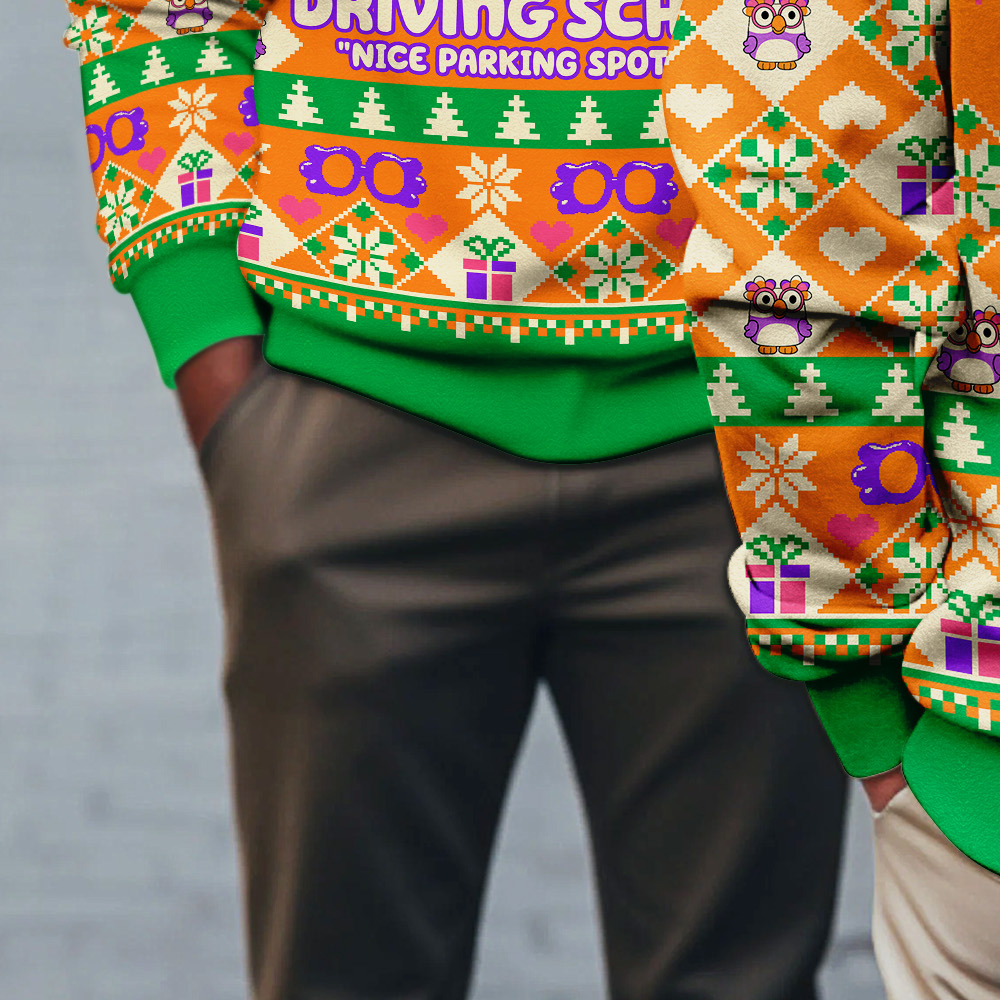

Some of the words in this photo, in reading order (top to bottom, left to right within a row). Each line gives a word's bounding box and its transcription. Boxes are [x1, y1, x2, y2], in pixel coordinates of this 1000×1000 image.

[335, 38, 430, 75] "NICE
[435, 44, 581, 80] PARKING
[584, 46, 668, 80] SPOT
